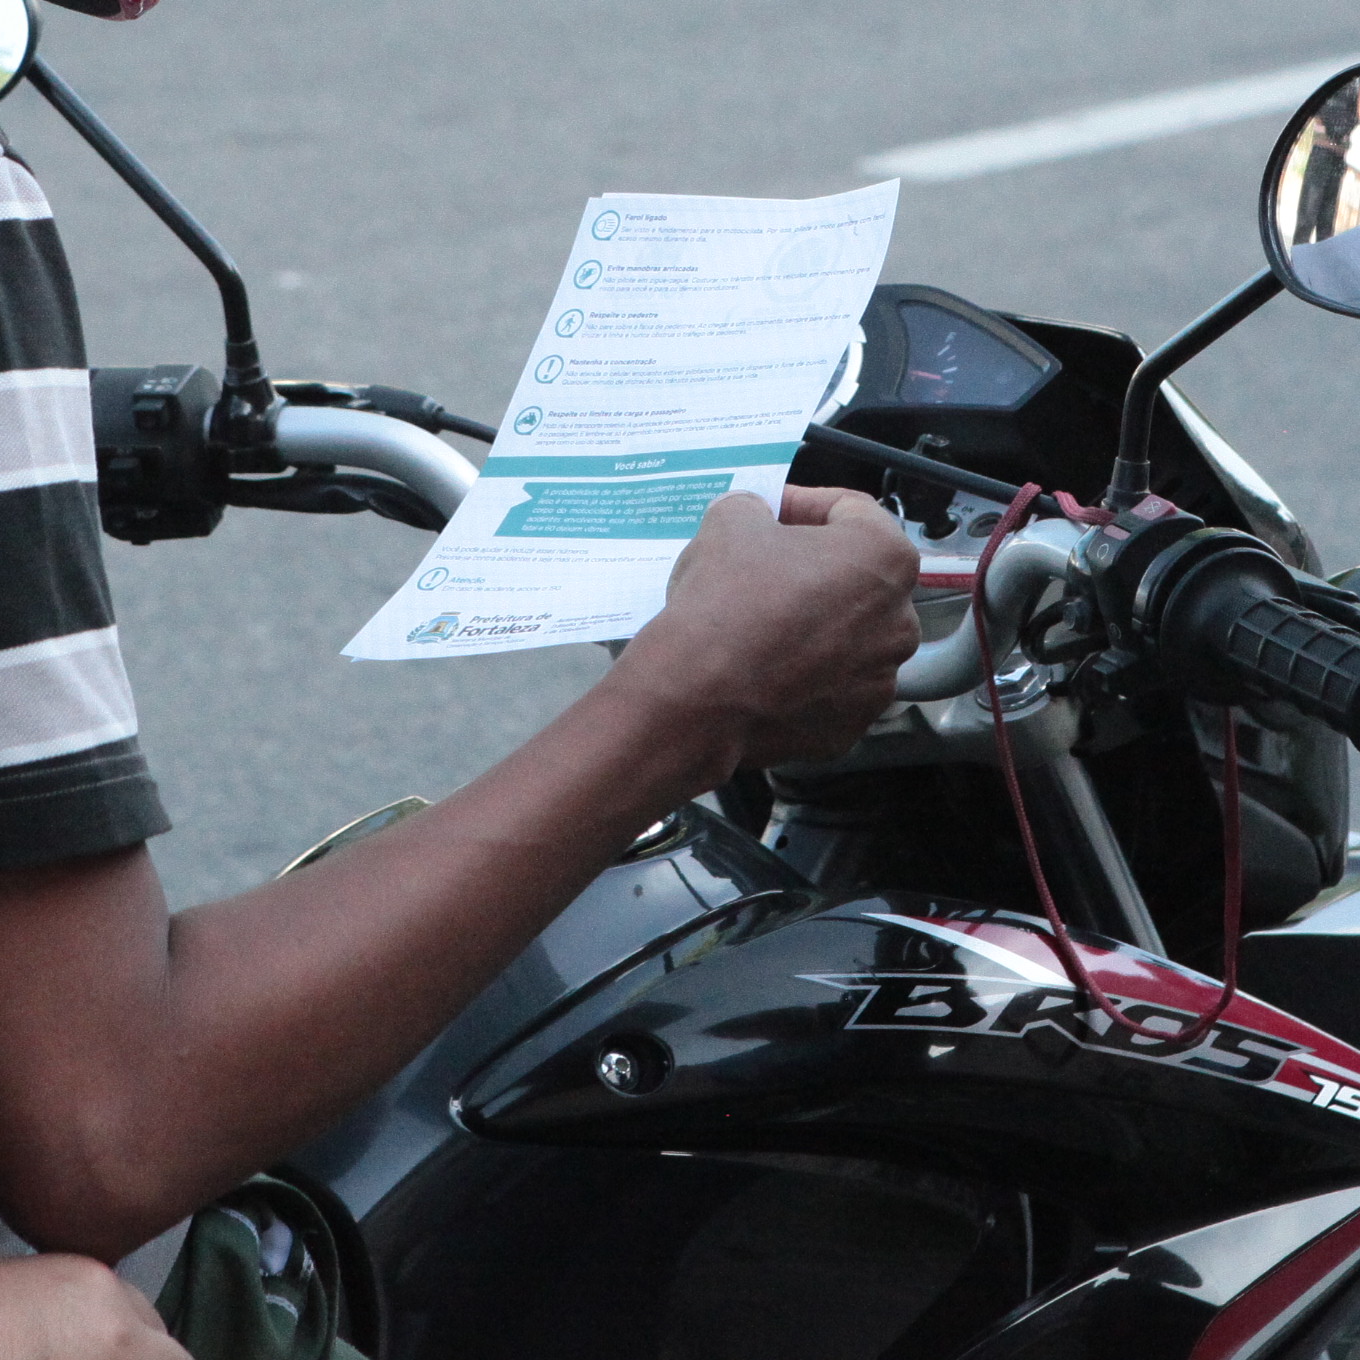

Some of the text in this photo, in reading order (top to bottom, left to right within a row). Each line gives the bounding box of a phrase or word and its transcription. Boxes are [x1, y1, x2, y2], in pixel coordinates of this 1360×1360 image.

[644, 214, 667, 222] ligado
[614, 458, 666, 471] Você sabia?
[469, 614, 533, 624] Prefeitura
[536, 612, 552, 620] de
[457, 623, 541, 637] Fortaleza
[846, 982, 1314, 1086] BROS
